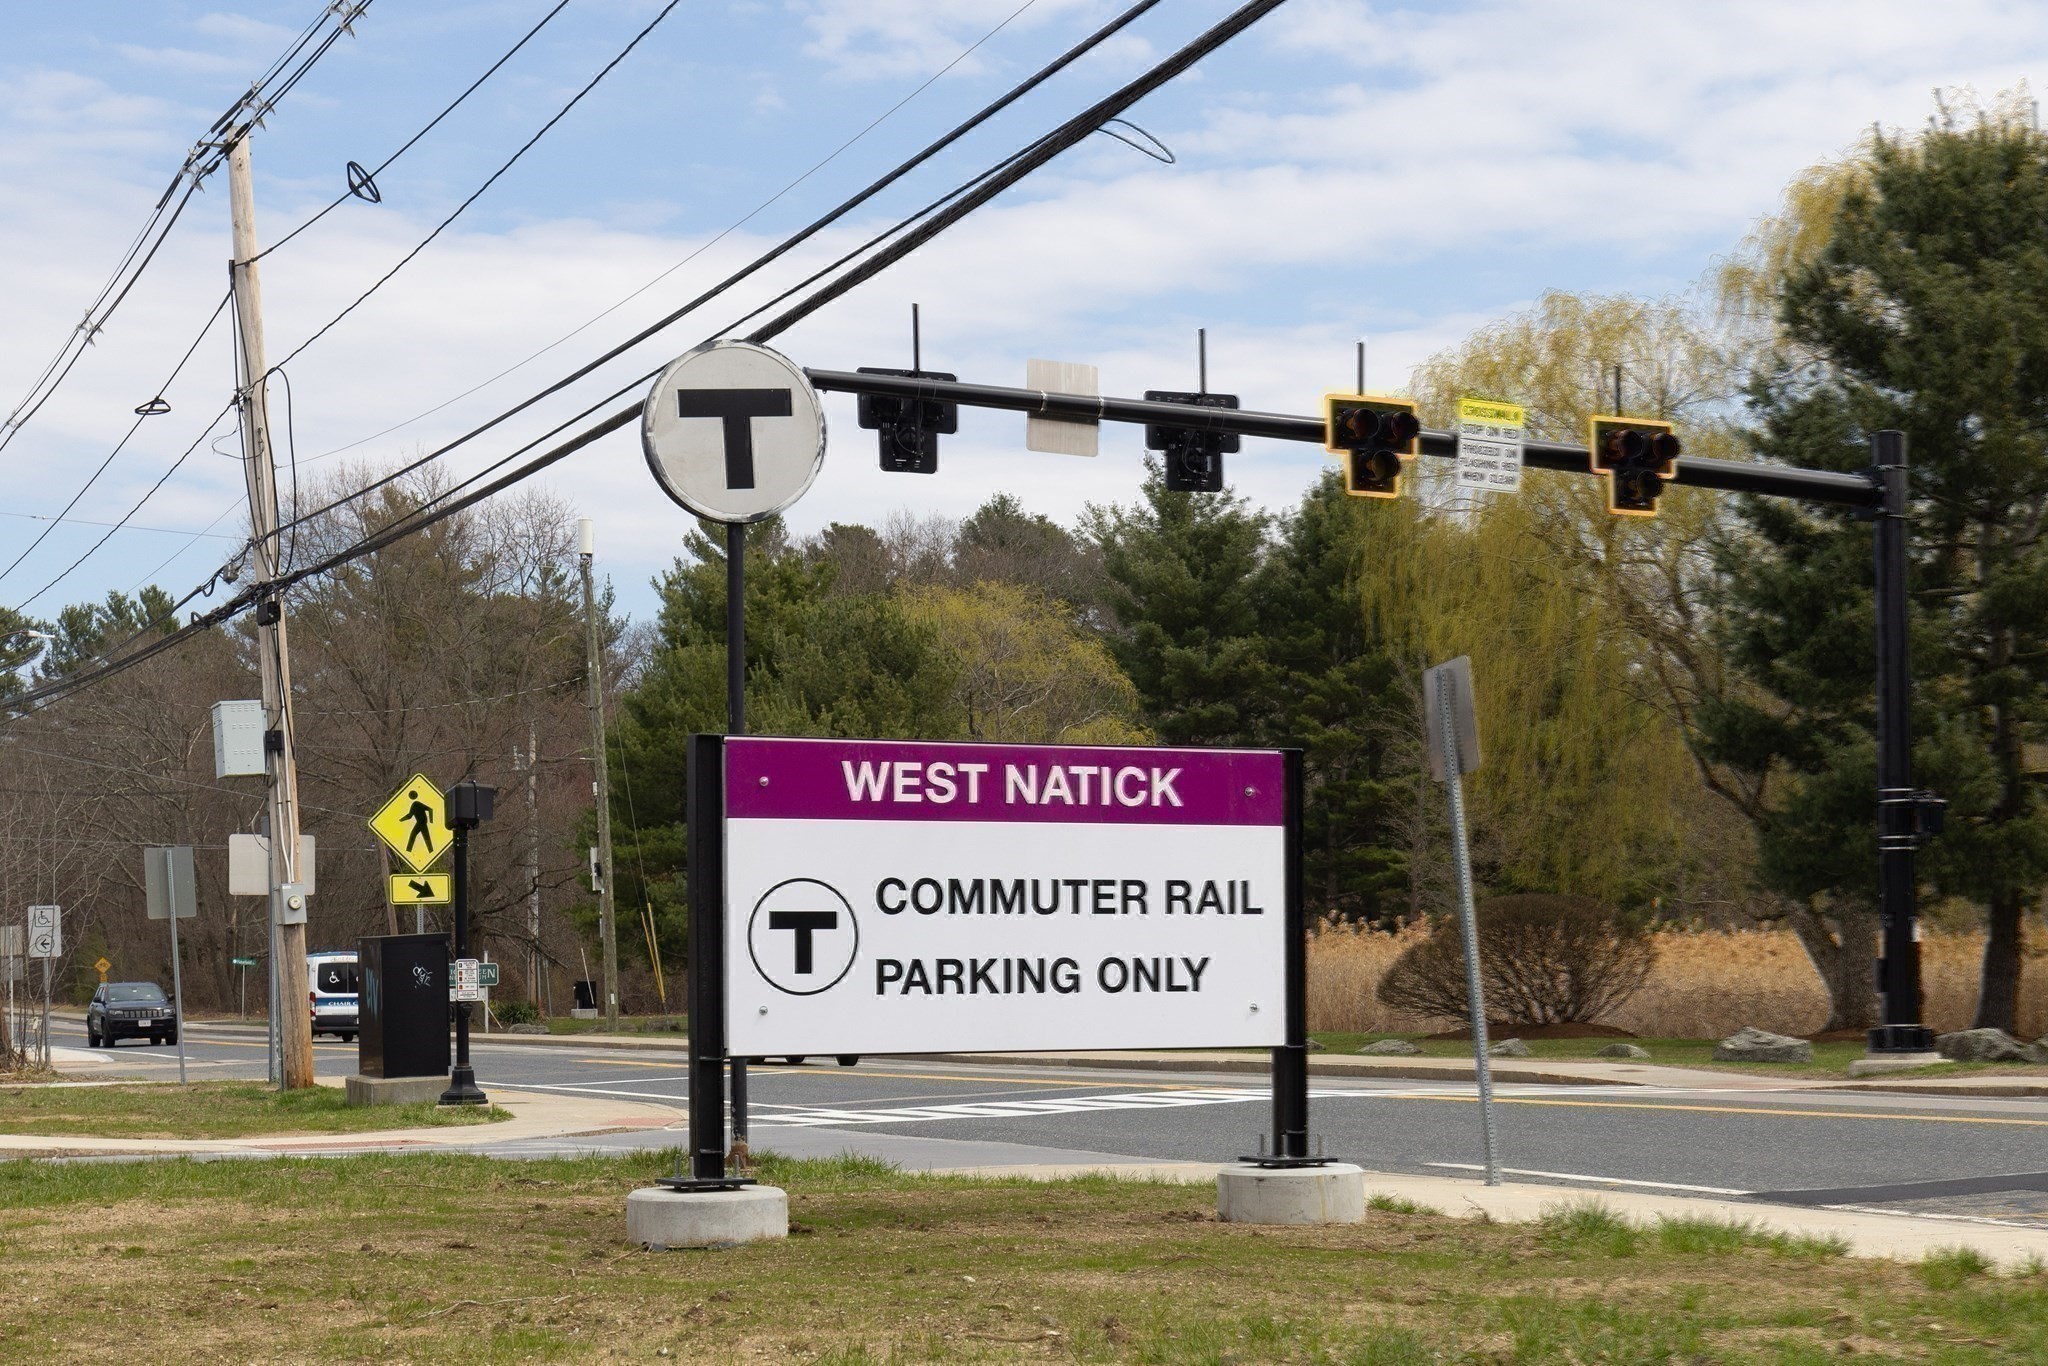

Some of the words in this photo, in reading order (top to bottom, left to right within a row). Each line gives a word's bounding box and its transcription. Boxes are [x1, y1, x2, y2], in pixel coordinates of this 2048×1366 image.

[677, 388, 792, 489] T
[841, 760, 988, 804] WEST
[1004, 763, 1183, 807] NATICK
[875, 877, 1148, 915] COMMUTER
[1164, 879, 1264, 915] RAIL
[768, 910, 838, 975] T
[875, 956, 1081, 995] PARKING
[1096, 956, 1210, 994] ONLY
